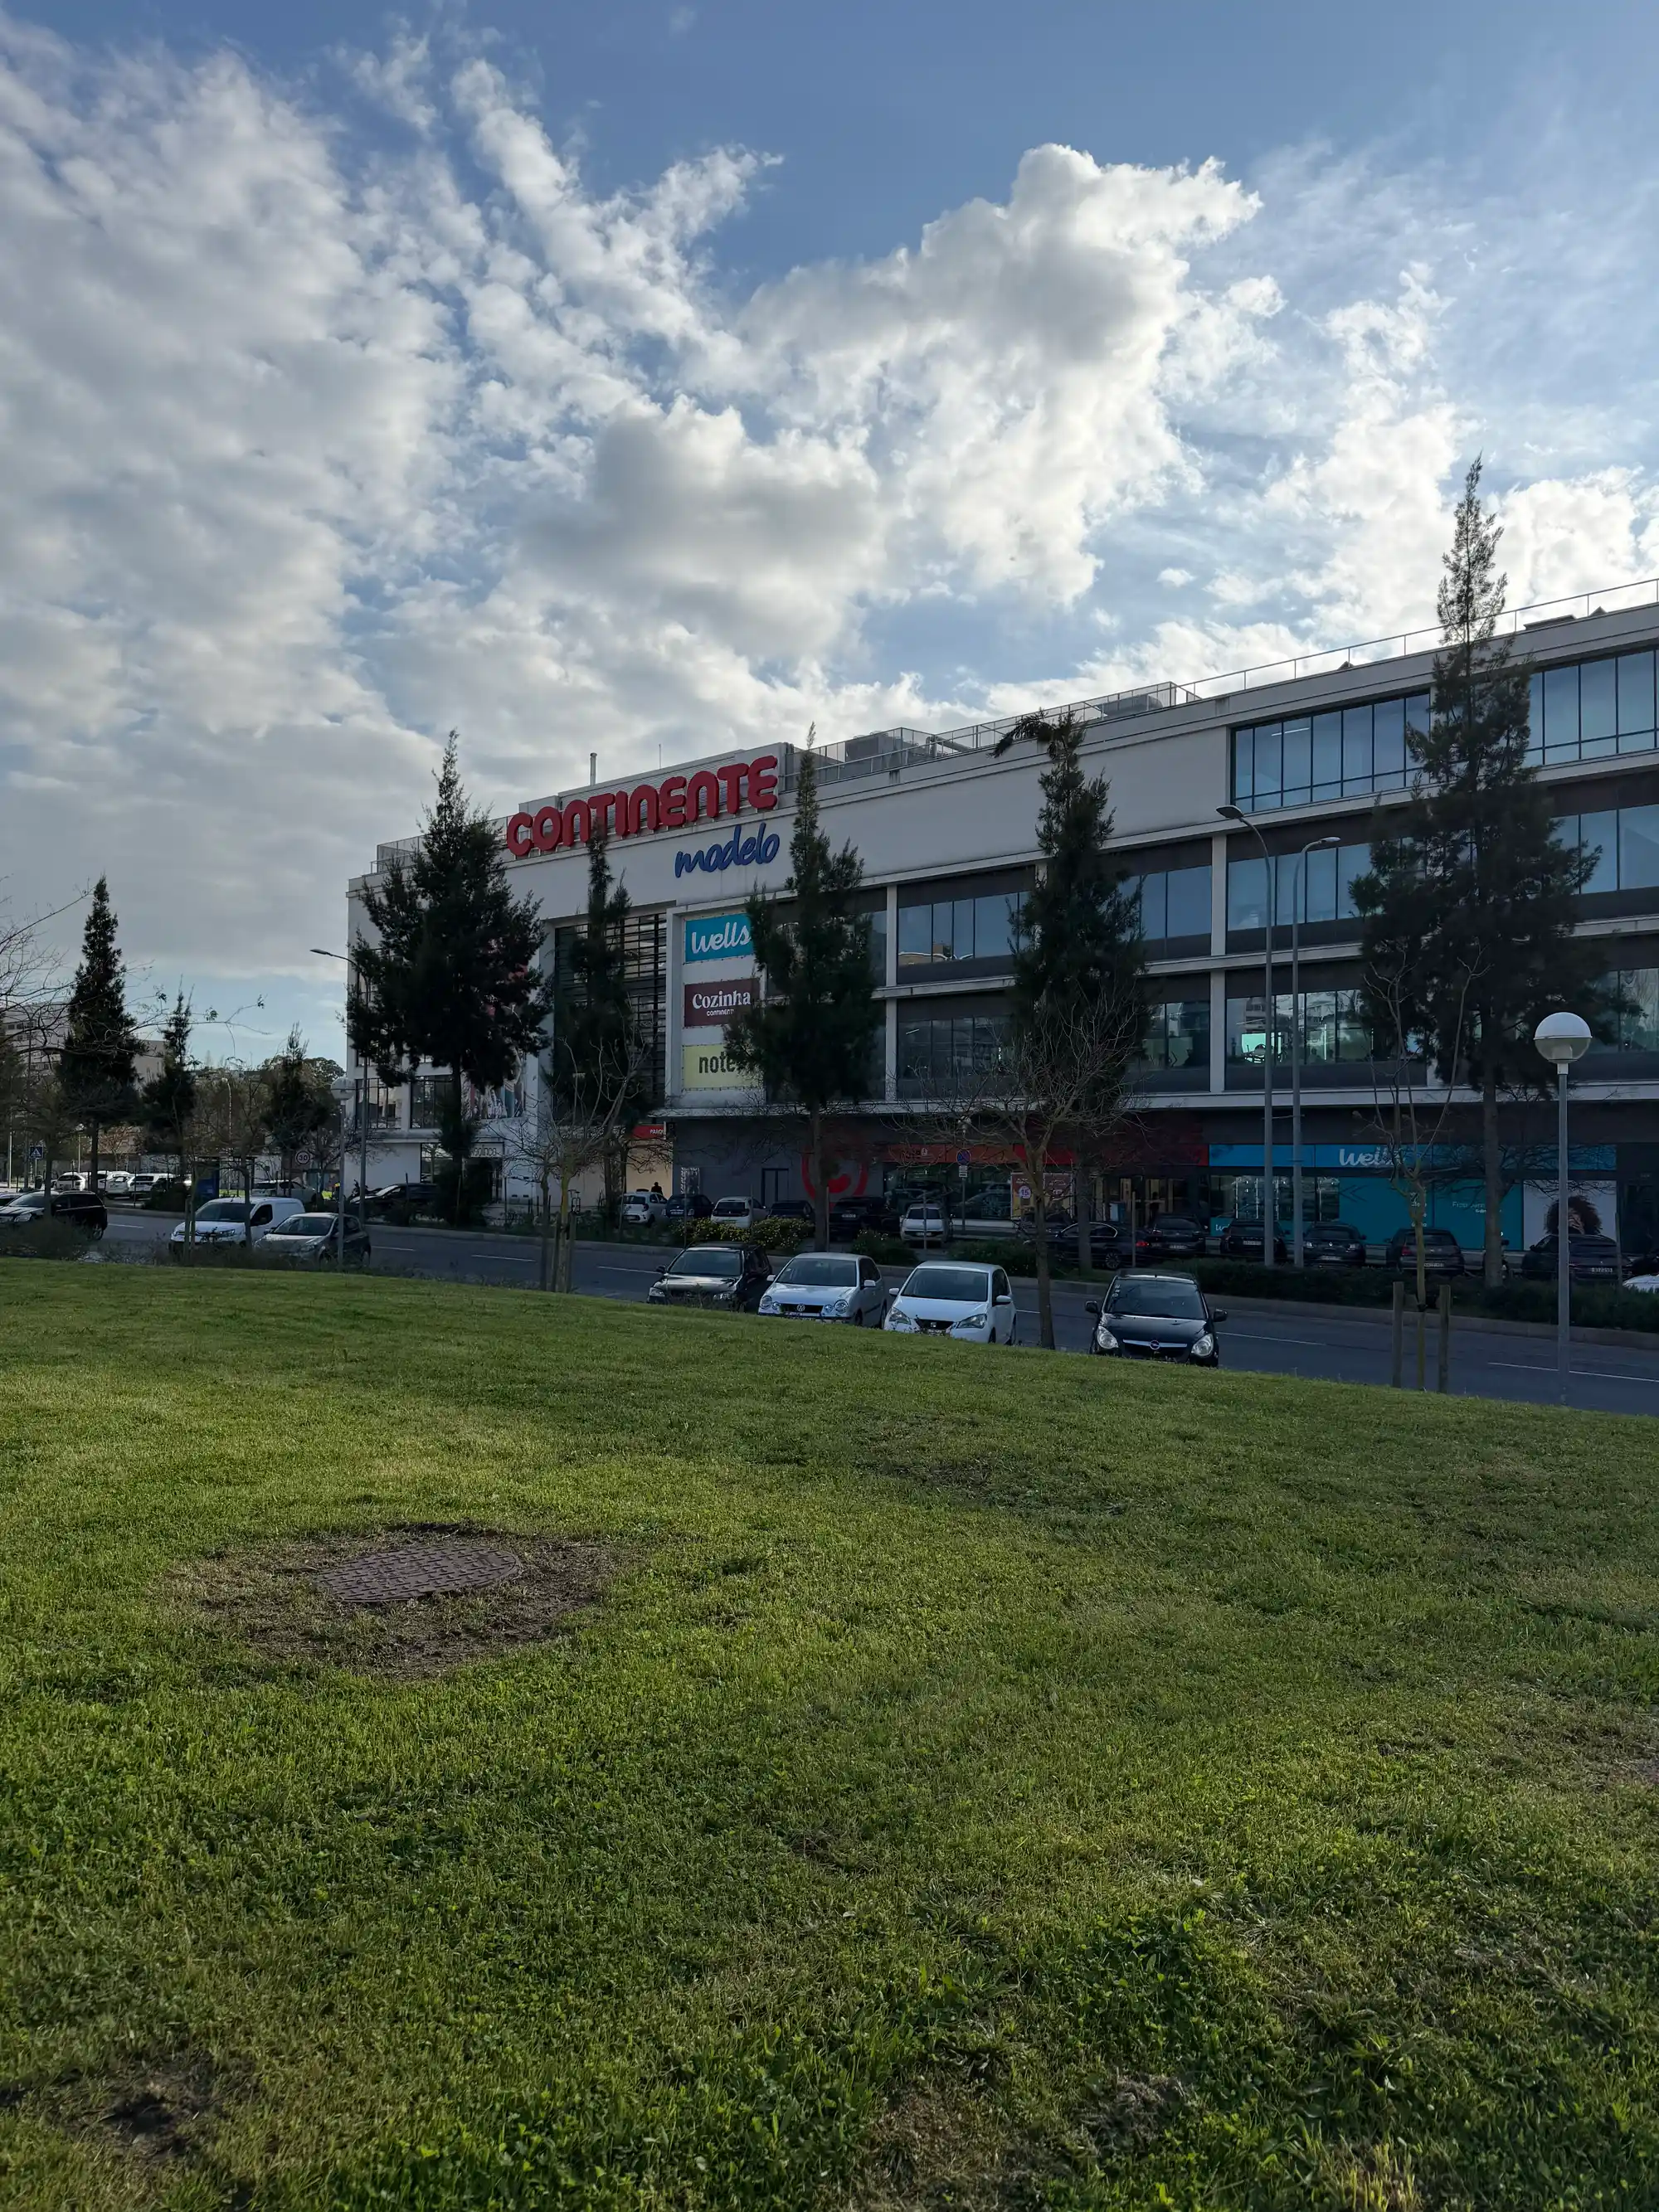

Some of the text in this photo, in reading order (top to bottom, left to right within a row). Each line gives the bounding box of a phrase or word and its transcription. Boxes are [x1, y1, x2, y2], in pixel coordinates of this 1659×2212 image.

[506, 755, 779, 857] CONTINENTE
[675, 822, 781, 879] modelo
[692, 989, 752, 1009] Cozinha
